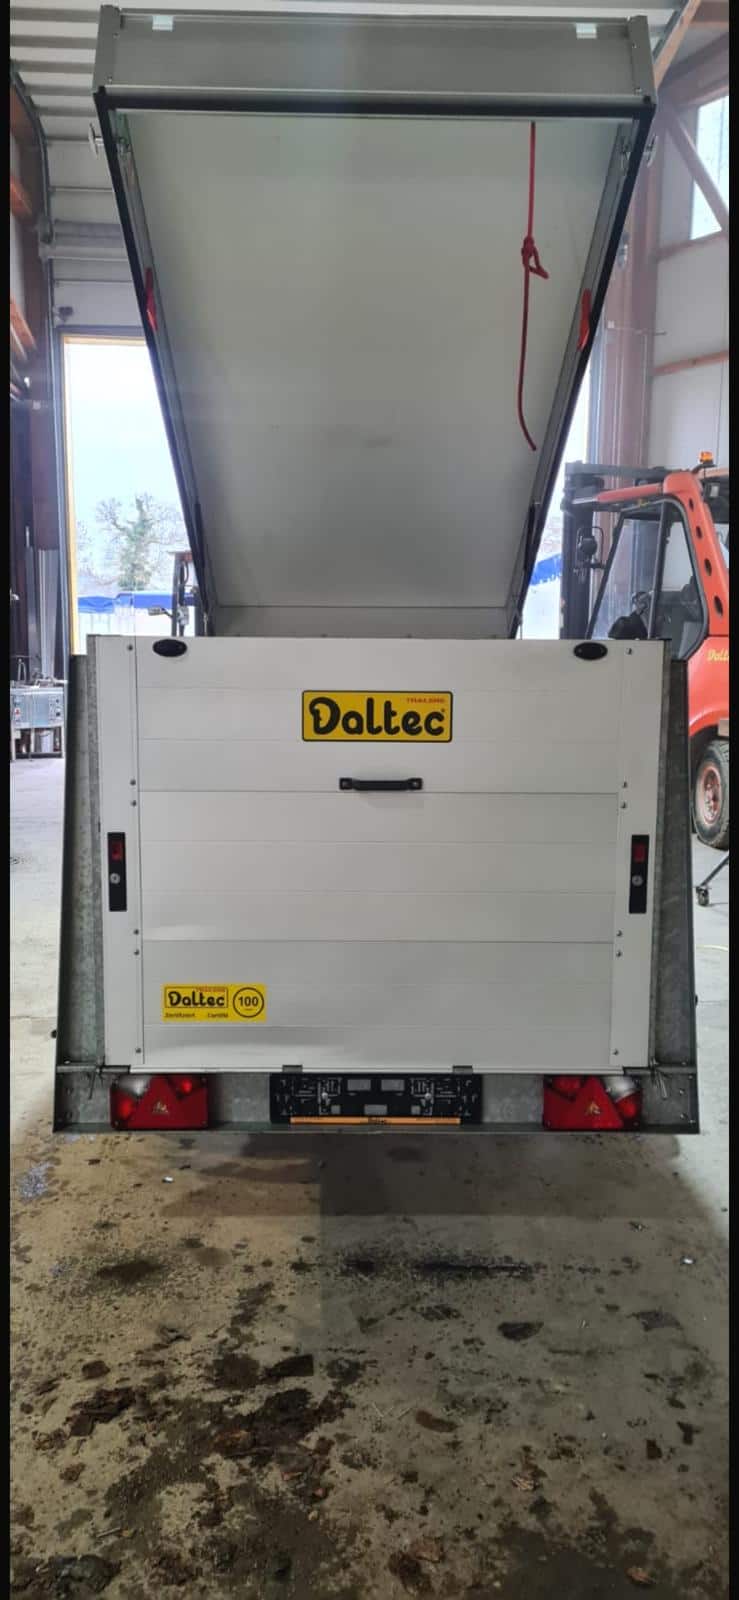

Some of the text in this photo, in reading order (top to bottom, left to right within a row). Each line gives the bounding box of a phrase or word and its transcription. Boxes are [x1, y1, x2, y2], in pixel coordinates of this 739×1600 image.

[309, 697, 445, 736] Daltec
[167, 990, 225, 1007] Daltec
[238, 996, 259, 1007] 100
